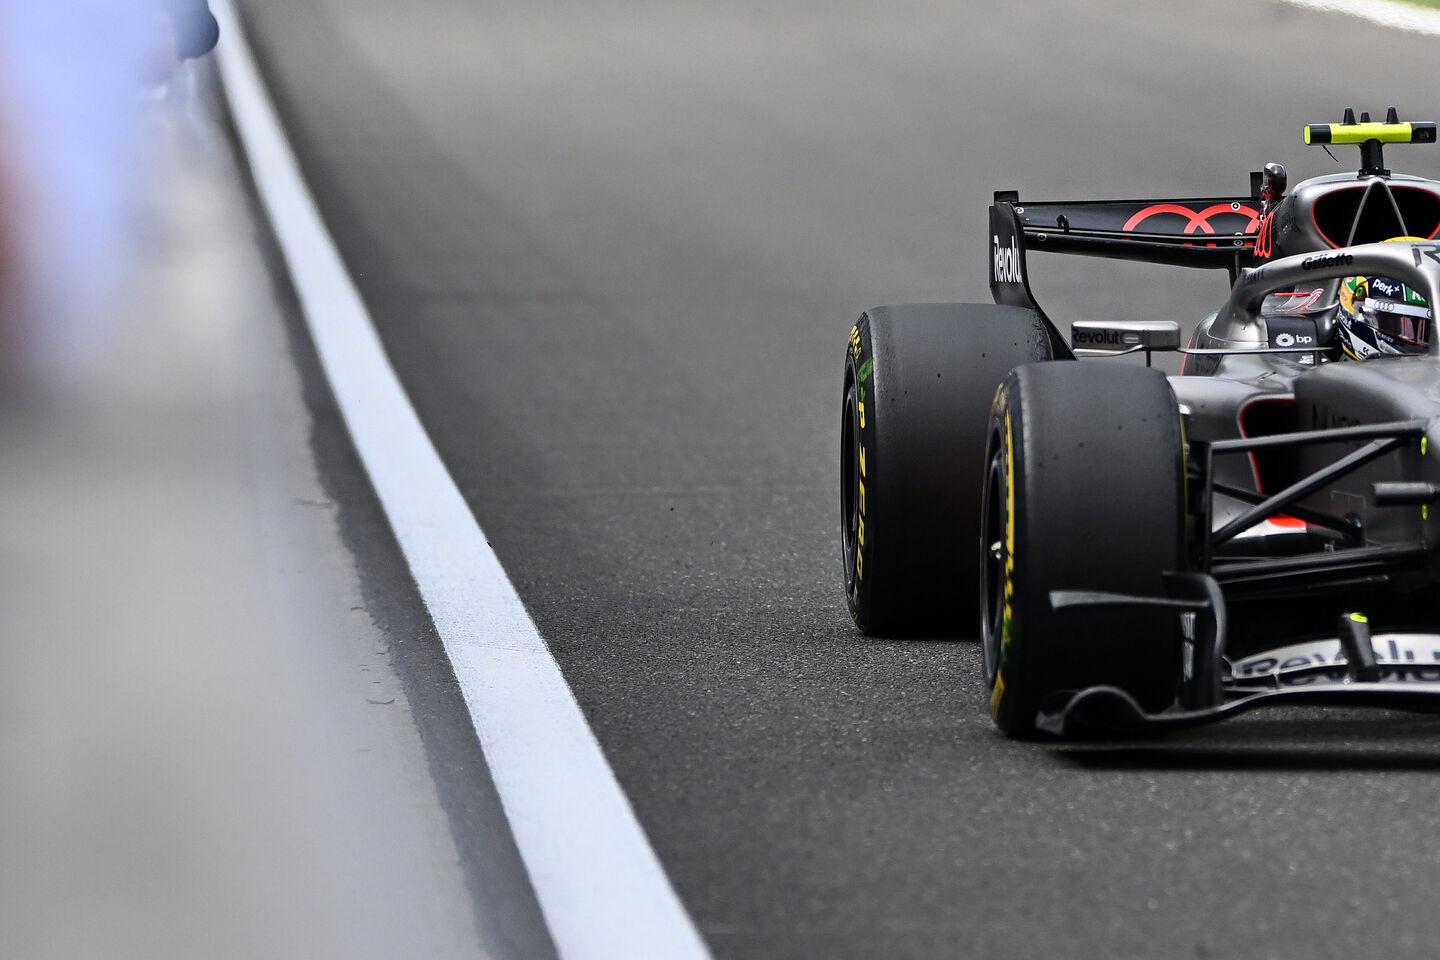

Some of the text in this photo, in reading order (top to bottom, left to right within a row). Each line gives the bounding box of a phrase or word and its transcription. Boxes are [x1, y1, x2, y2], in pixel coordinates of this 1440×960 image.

[1301, 252, 1354, 271] Gillette
[1072, 328, 1119, 345] Revolut
[1296, 334, 1312, 344] bp
